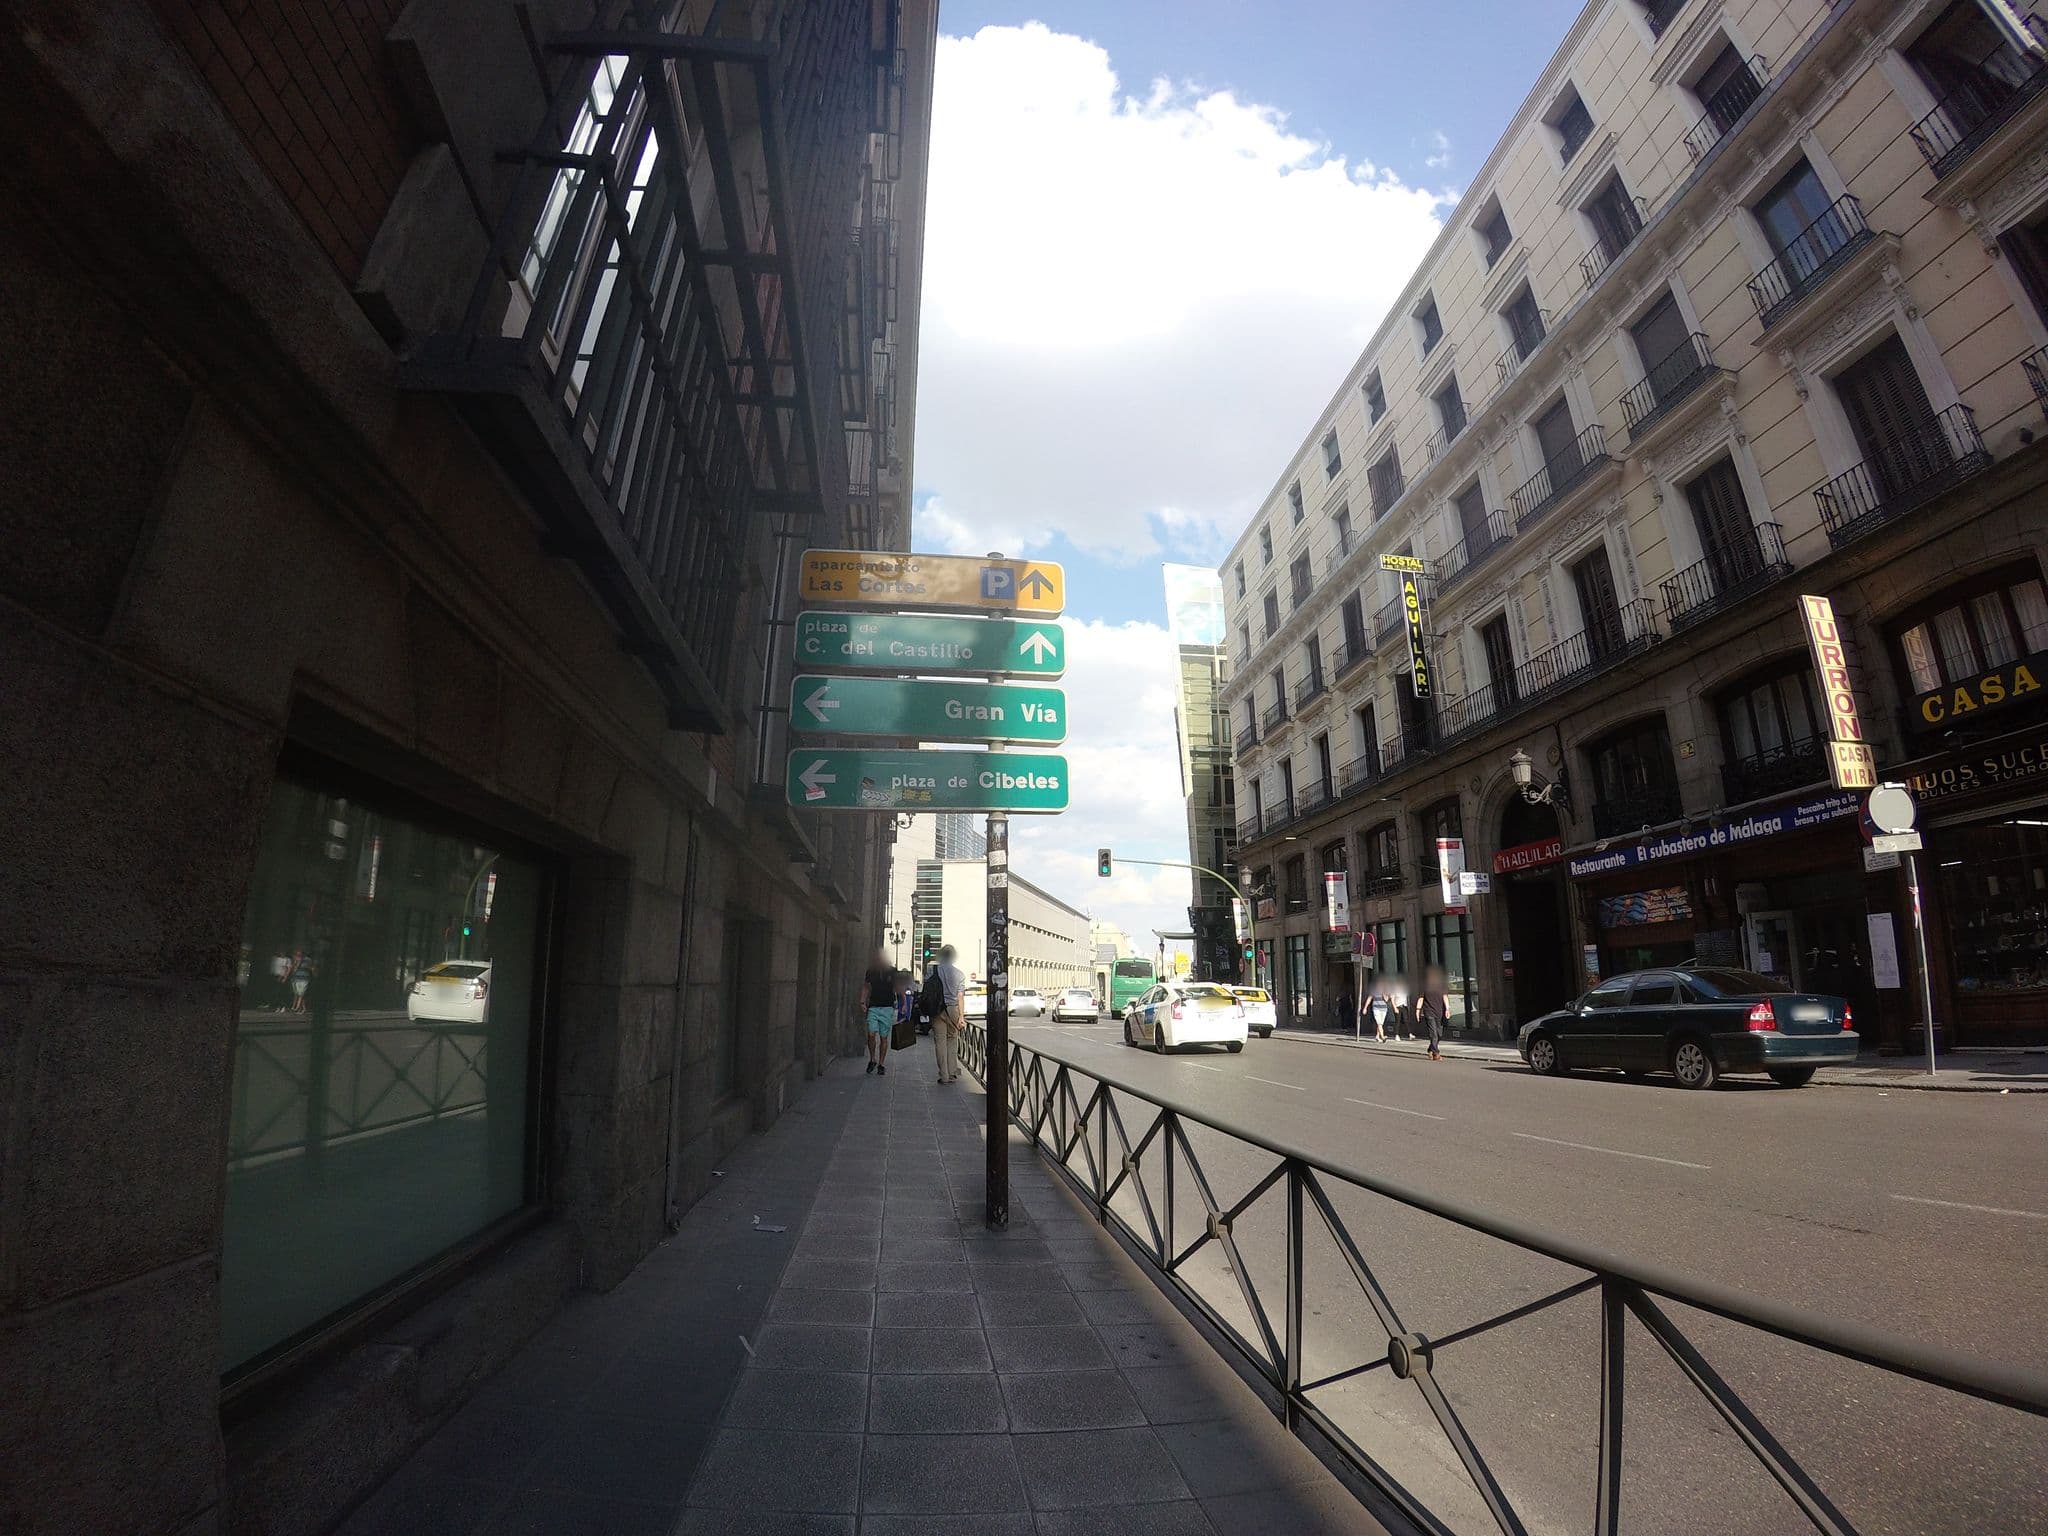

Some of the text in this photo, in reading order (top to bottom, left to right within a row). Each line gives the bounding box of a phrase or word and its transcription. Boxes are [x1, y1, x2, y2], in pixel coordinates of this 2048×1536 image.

[809, 559, 920, 573] aparcamiento
[1382, 555, 1423, 568] HOSTAL
[808, 576, 927, 594] Las Cortes
[804, 620, 878, 634] plaza de
[1404, 581, 1427, 686] AGUILAR
[804, 637, 973, 660] C. del Castillo
[1808, 597, 1861, 739] TURRON
[1921, 664, 2041, 722] CASA
[944, 699, 1057, 723] Gran Vía
[1838, 746, 1871, 763] CASA
[891, 770, 1060, 790] plaza de Cibeles
[1843, 768, 1876, 785] MIRA
[1919, 780, 1981, 800] DULCES
[1825, 797, 1841, 809] frito
[1847, 793, 1857, 802] la
[1794, 804, 1859, 826] brasa y su subasta
[1570, 815, 1783, 876] Restaurante El subastero de Málaga
